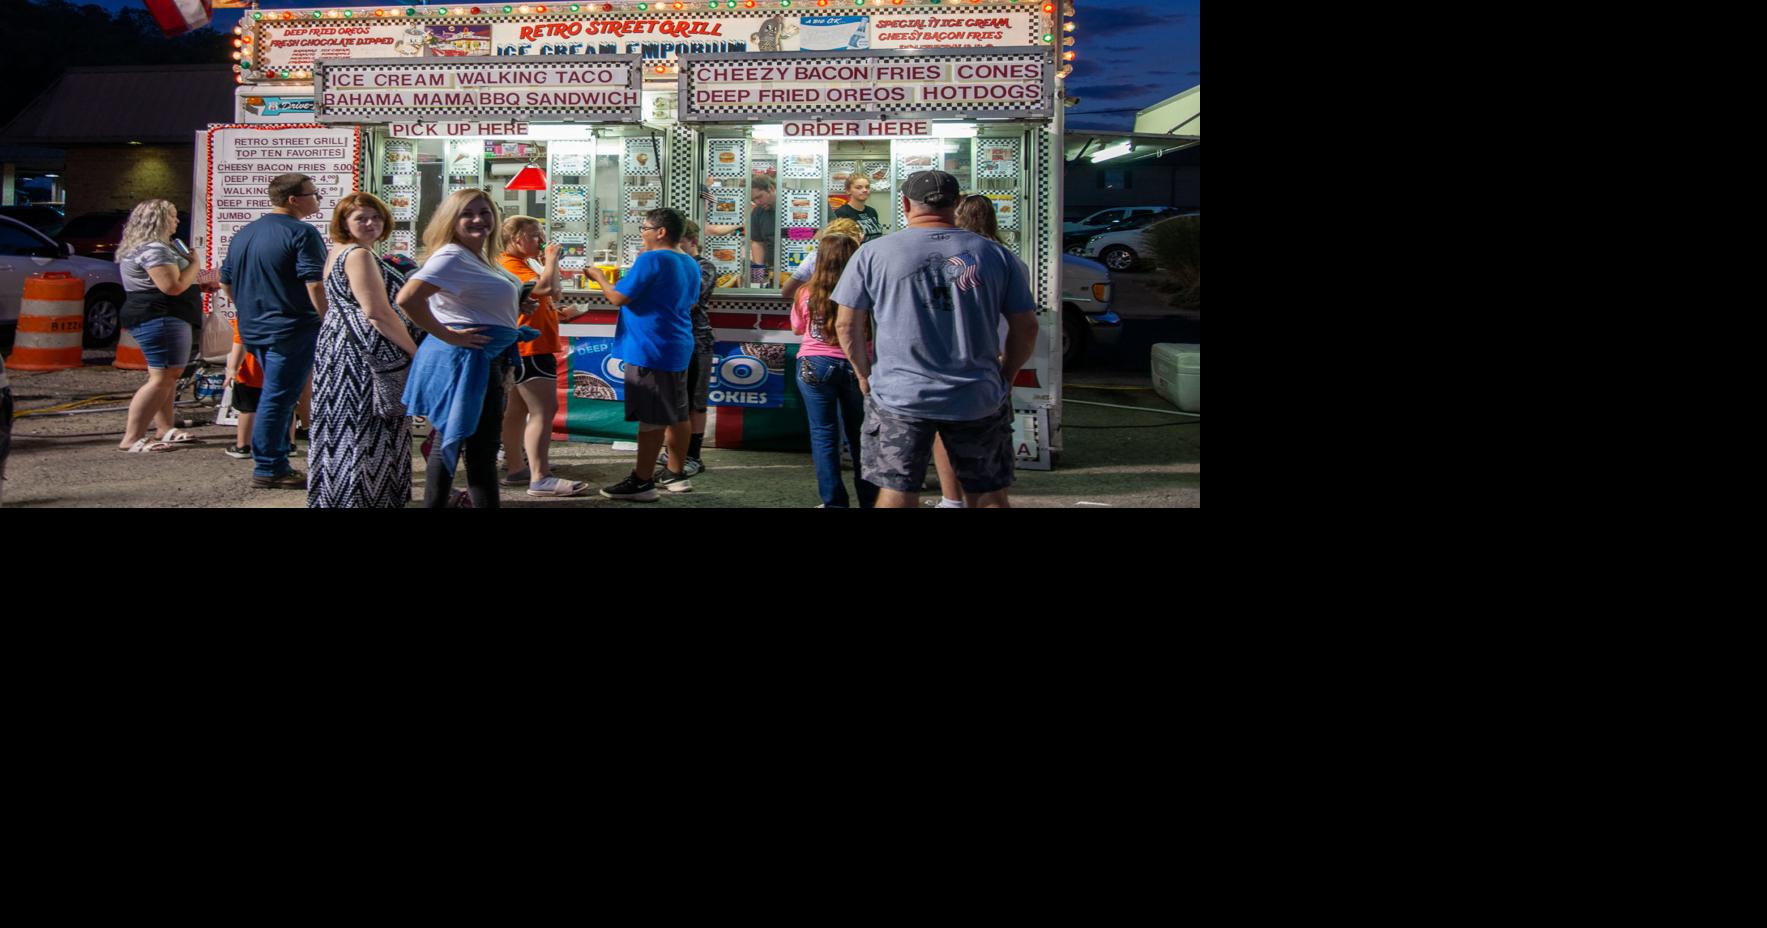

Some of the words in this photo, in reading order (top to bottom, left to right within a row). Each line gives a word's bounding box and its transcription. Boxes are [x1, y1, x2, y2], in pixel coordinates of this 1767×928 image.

[876, 18, 939, 29] SPECIALTY
[939, 19, 964, 28] ICE
[965, 18, 1012, 28] CREAM
[309, 28, 337, 36] FRIED
[338, 27, 370, 36] OREOS
[520, 22, 582, 42] RETRO
[586, 20, 660, 37] STREET
[659, 20, 723, 37] GRILL
[878, 31, 922, 41] CHEESY
[921, 32, 965, 40] BACON
[966, 31, 1003, 40] FRIES
[271, 40, 300, 48] FRESH
[300, 38, 356, 47] CHOCOLATE
[355, 37, 394, 45] DIPPED
[497, 42, 531, 56] ICE
[541, 41, 616, 56] CREAM
[626, 40, 747, 59] EMPORIUM
[332, 74, 364, 86] ICE
[374, 73, 444, 86] CREAM
[457, 71, 547, 85] WALKING
[556, 71, 612, 84] TACO
[697, 67, 789, 81] CHEEZY
[795, 66, 868, 80] BACON
[877, 65, 940, 80] FRIES
[957, 64, 1039, 79] CONES
[324, 94, 404, 106] BAHAMA
[413, 93, 475, 105] MAMA
[479, 93, 520, 106] BBQ
[527, 92, 637, 105] SANDWICH
[697, 90, 750, 102] DEEP
[759, 89, 820, 102] FRIED
[826, 87, 905, 101] OREOS
[923, 84, 1039, 100] HOTDOGS
[393, 124, 438, 136] PICK
[447, 123, 471, 135] UP
[478, 123, 528, 135] HERE
[784, 122, 860, 136] ORDER
[868, 121, 928, 134] HERE
[234, 138, 268, 146] RETRO
[313, 137, 343, 145] GRILL
[286, 149, 341, 157] FAVORITES
[217, 163, 253, 171] CHEESY
[257, 163, 293, 171] BACON
[297, 163, 326, 171] FRIES
[333, 163, 353, 171] 5.00
[217, 212, 252, 220] JUMBO
[577, 344, 608, 356] DEEP
[708, 390, 768, 405] OKIES
